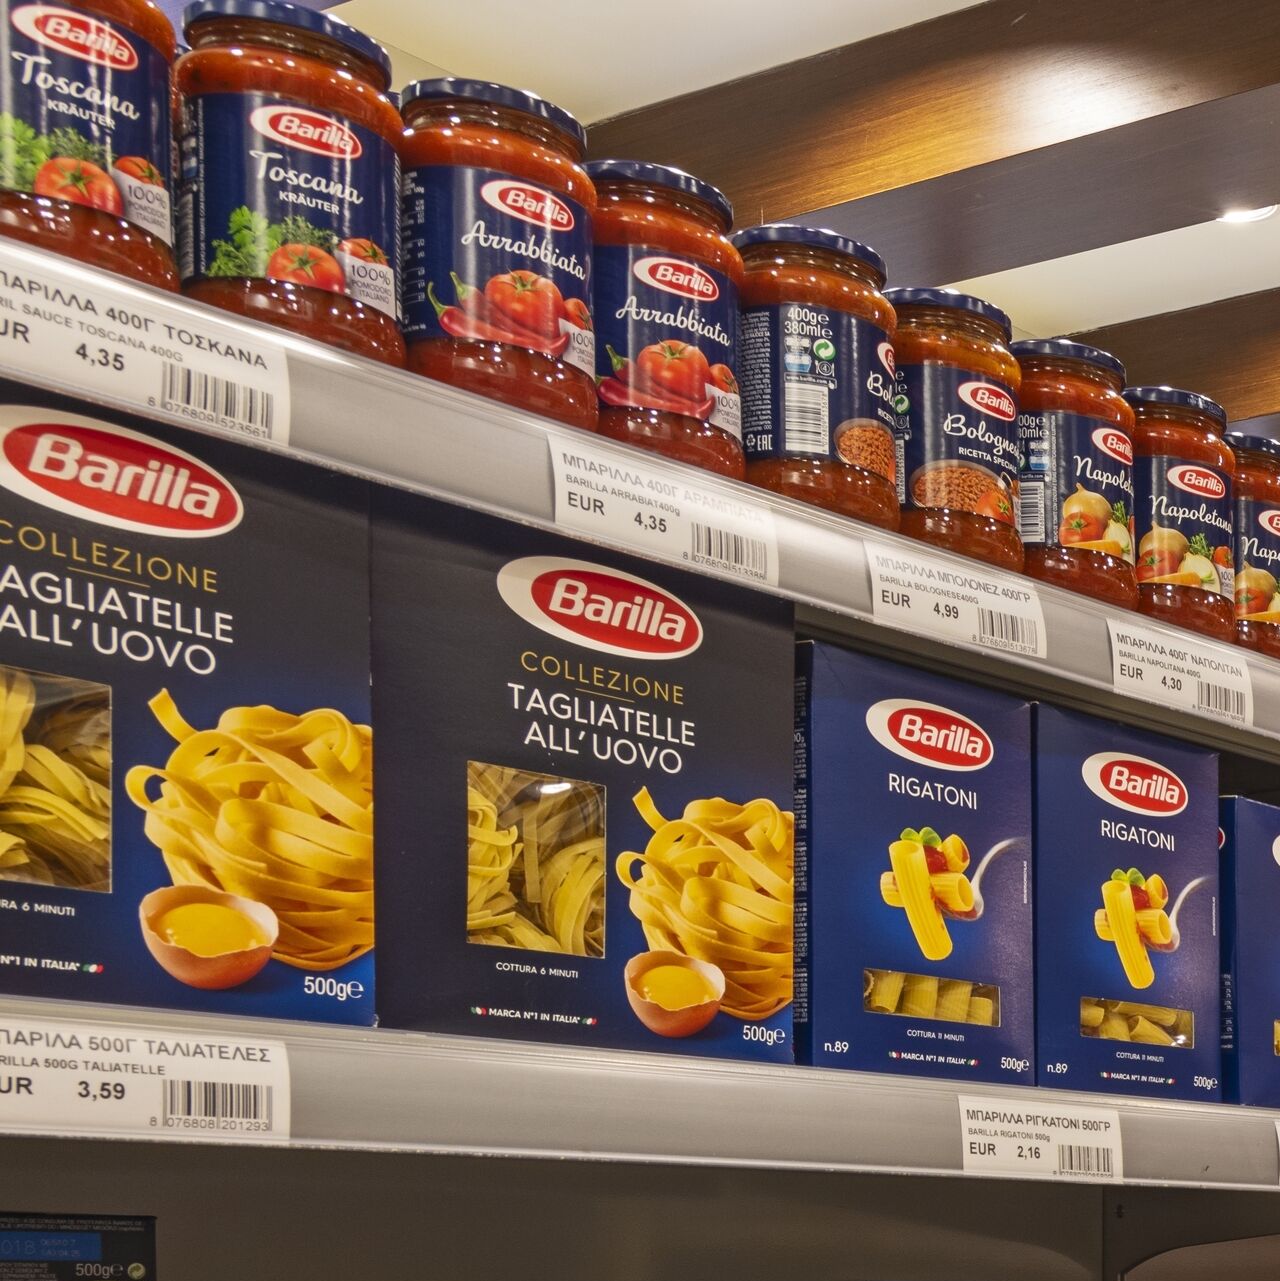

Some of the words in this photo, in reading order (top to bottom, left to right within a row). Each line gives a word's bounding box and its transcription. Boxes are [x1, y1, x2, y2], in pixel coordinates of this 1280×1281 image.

[45, 17, 129, 62] Barilla
[11, 51, 140, 120] Toscana
[47, 99, 116, 130] KRÄUTER
[277, 115, 353, 151] Barilla
[249, 150, 363, 204] Toscana
[279, 191, 340, 215] KRÄUTER
[505, 190, 570, 224] Barilla
[461, 220, 587, 281] Arrabbiata
[655, 265, 714, 295] Barilla
[106, 307, 153, 332] 400Γ
[163, 323, 268, 370] ΤΟΣΚΑΝΑ
[615, 296, 730, 347] Arrabbiata
[76, 343, 125, 371] 4,35
[28, 432, 221, 520] Barilla
[567, 491, 606, 515] EUR
[633, 511, 668, 533] 4,35
[549, 577, 686, 644] Barilla
[520, 652, 686, 705] COLLEZIONE
[507, 683, 696, 747] TAGLIATELLE
[898, 715, 983, 757] Barilla
[888, 772, 978, 810] RIGATONI
[1109, 766, 1180, 804] Barilla
[1100, 820, 1176, 853] RIGATONI
[88, 1037, 136, 1052] 500Γ
[145, 1041, 271, 1062] ΤΑΛΙΑΤΕΛΕΣ
[77, 1081, 125, 1100] 3,59
[966, 1108, 1023, 1126] ΜΠΑΡΙΛΛΑ
[1026, 1113, 1080, 1130] ΡΙΓΚΑΤΟΝΙ
[1082, 1117, 1111, 1132] 500ΓΡ
[969, 1141, 996, 1158] EUR
[1017, 1146, 1041, 1161] 2,16
